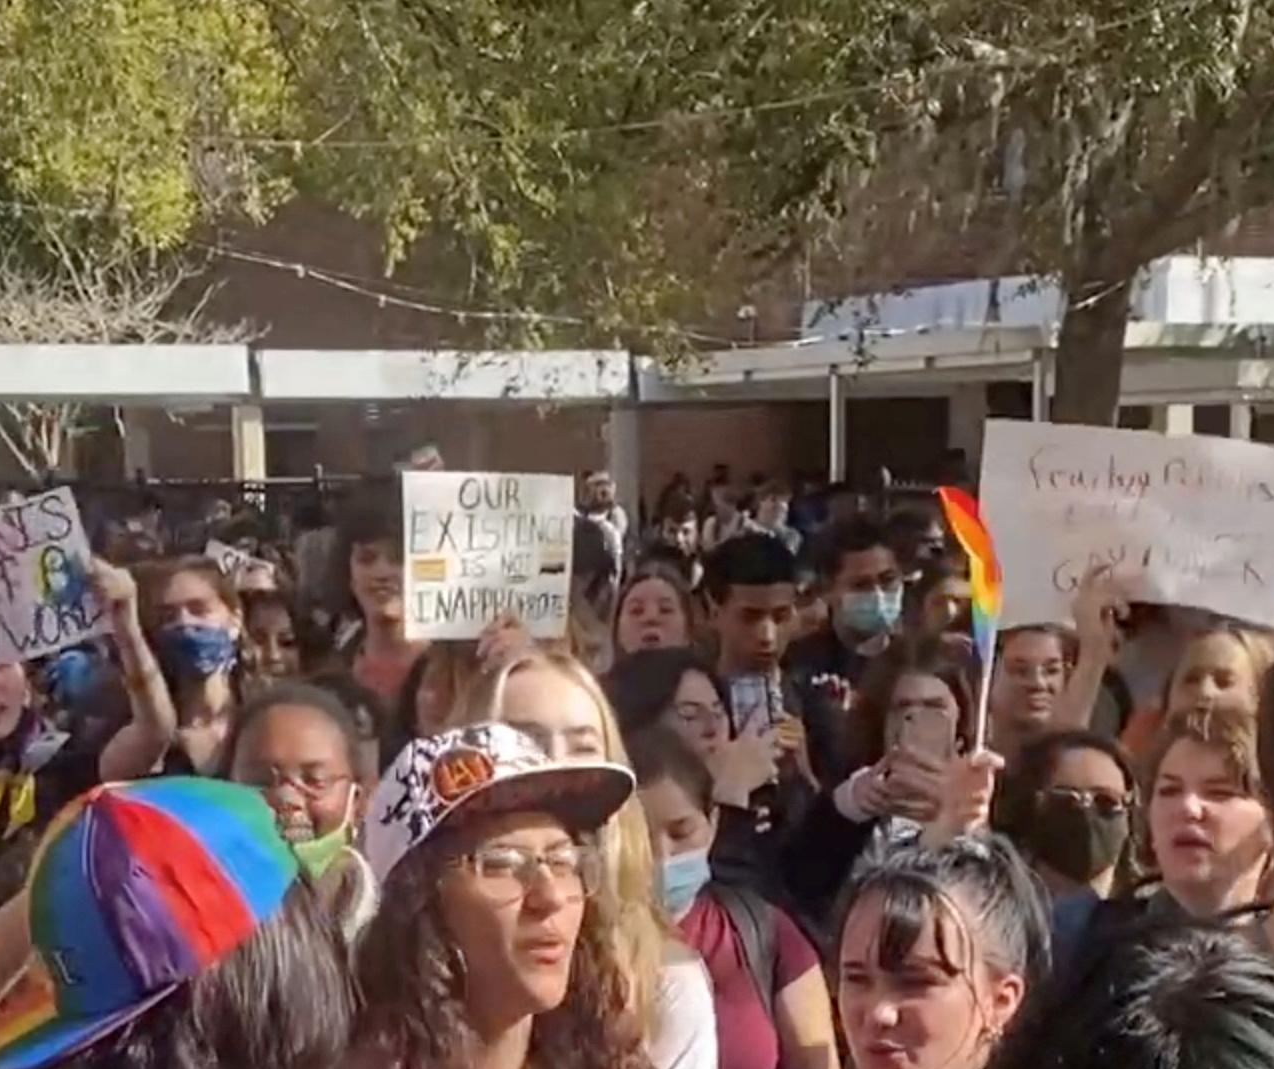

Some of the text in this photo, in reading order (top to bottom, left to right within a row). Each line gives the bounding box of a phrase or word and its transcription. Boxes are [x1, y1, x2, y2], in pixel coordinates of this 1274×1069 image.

[458, 477, 521, 511] OUR
[410, 508, 570, 554] EXISTENCE
[460, 552, 531, 578] IS NOT
